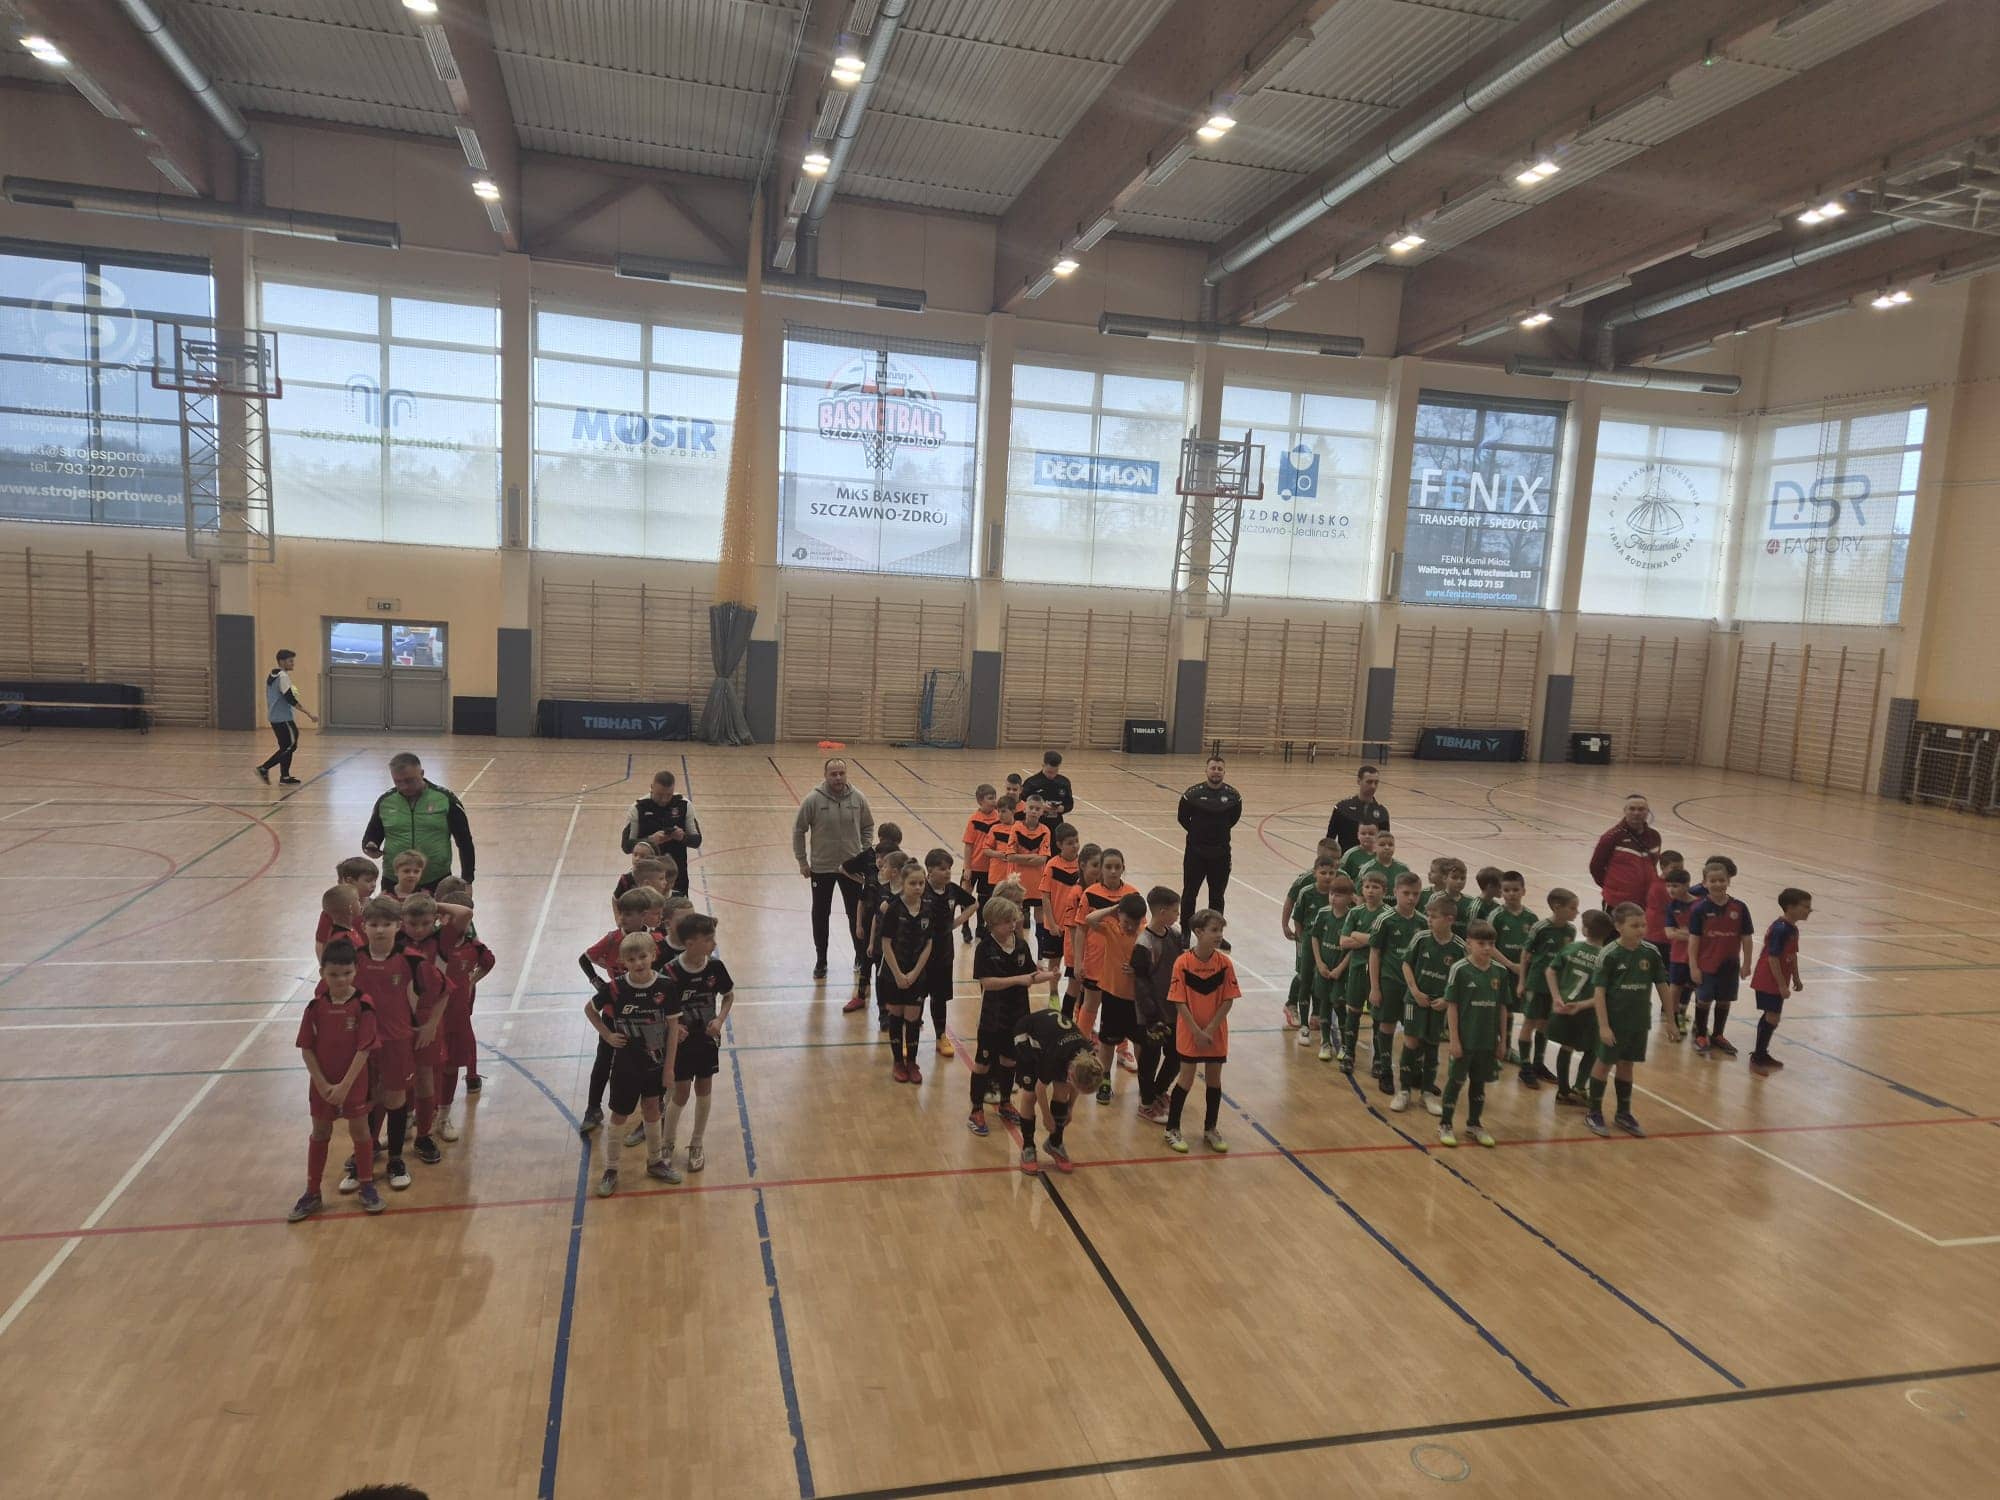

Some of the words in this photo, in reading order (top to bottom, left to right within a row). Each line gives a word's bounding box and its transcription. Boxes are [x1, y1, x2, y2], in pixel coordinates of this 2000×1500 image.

[818, 398, 946, 440] BASKETBALL
[55, 462, 84, 476] 793
[87, 465, 115, 478] 222
[118, 467, 145, 479] 071
[837, 487, 869, 502] MKS
[873, 489, 929, 506] BASKET
[1418, 468, 1545, 515] FENIX
[810, 502, 948, 526] SZCZAWNO-ZDRÓJ
[1418, 513, 1482, 528] TRANSPORT
[1488, 517, 1539, 532] SPEDYCJA
[1783, 535, 1865, 554] FACTORY
[1441, 554, 1464, 564] FENIX
[1465, 555, 1486, 565] Kamil
[581, 716, 643, 730] TIBHAR
[1435, 735, 1482, 750] TIBHAR
[1567, 967, 1589, 1001] 7
